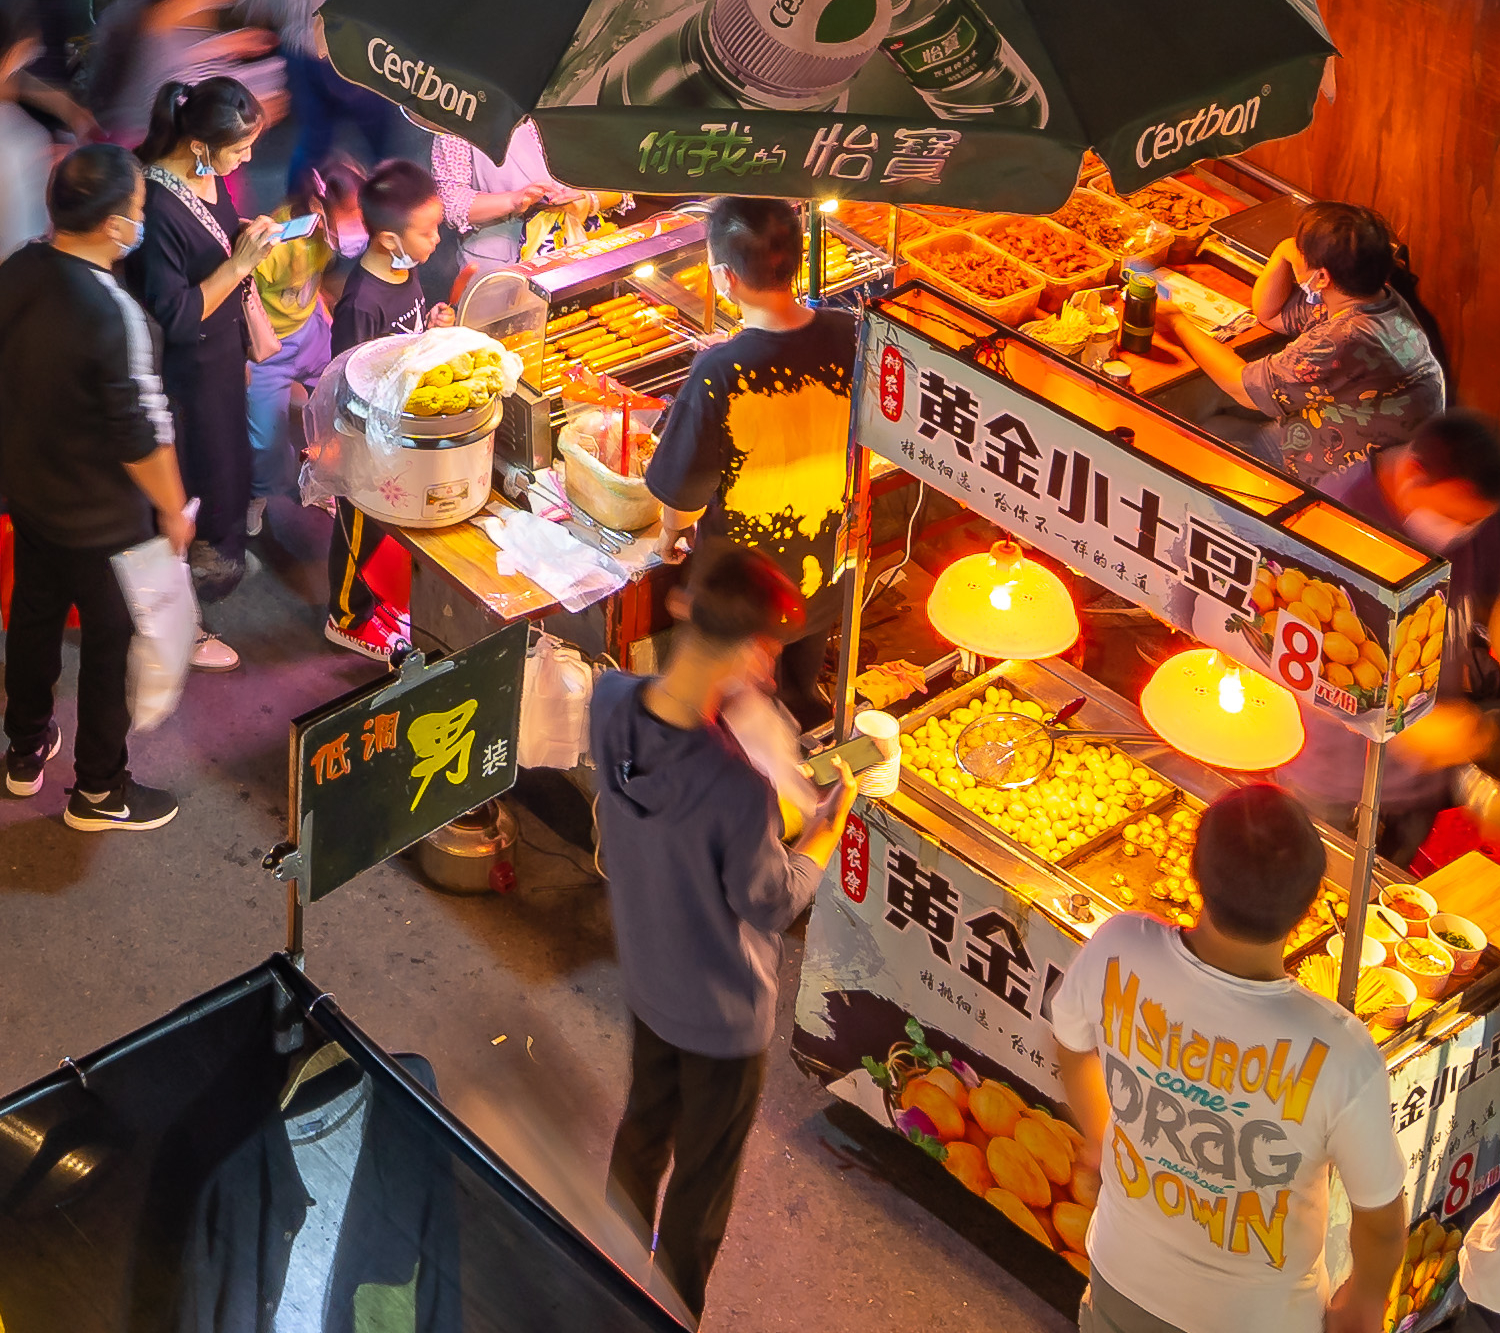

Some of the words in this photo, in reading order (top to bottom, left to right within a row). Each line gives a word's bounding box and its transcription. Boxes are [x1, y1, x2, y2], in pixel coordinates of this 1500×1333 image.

[366, 36, 478, 123] C'estbon
[637, 120, 787, 178] 你我的
[802, 121, 962, 186] 怡寶
[1133, 90, 1262, 171] C'estbon
[916, 366, 1262, 619] 黄金小土豆
[1280, 619, 1316, 693] 8
[310, 698, 511, 813] 低调男装
